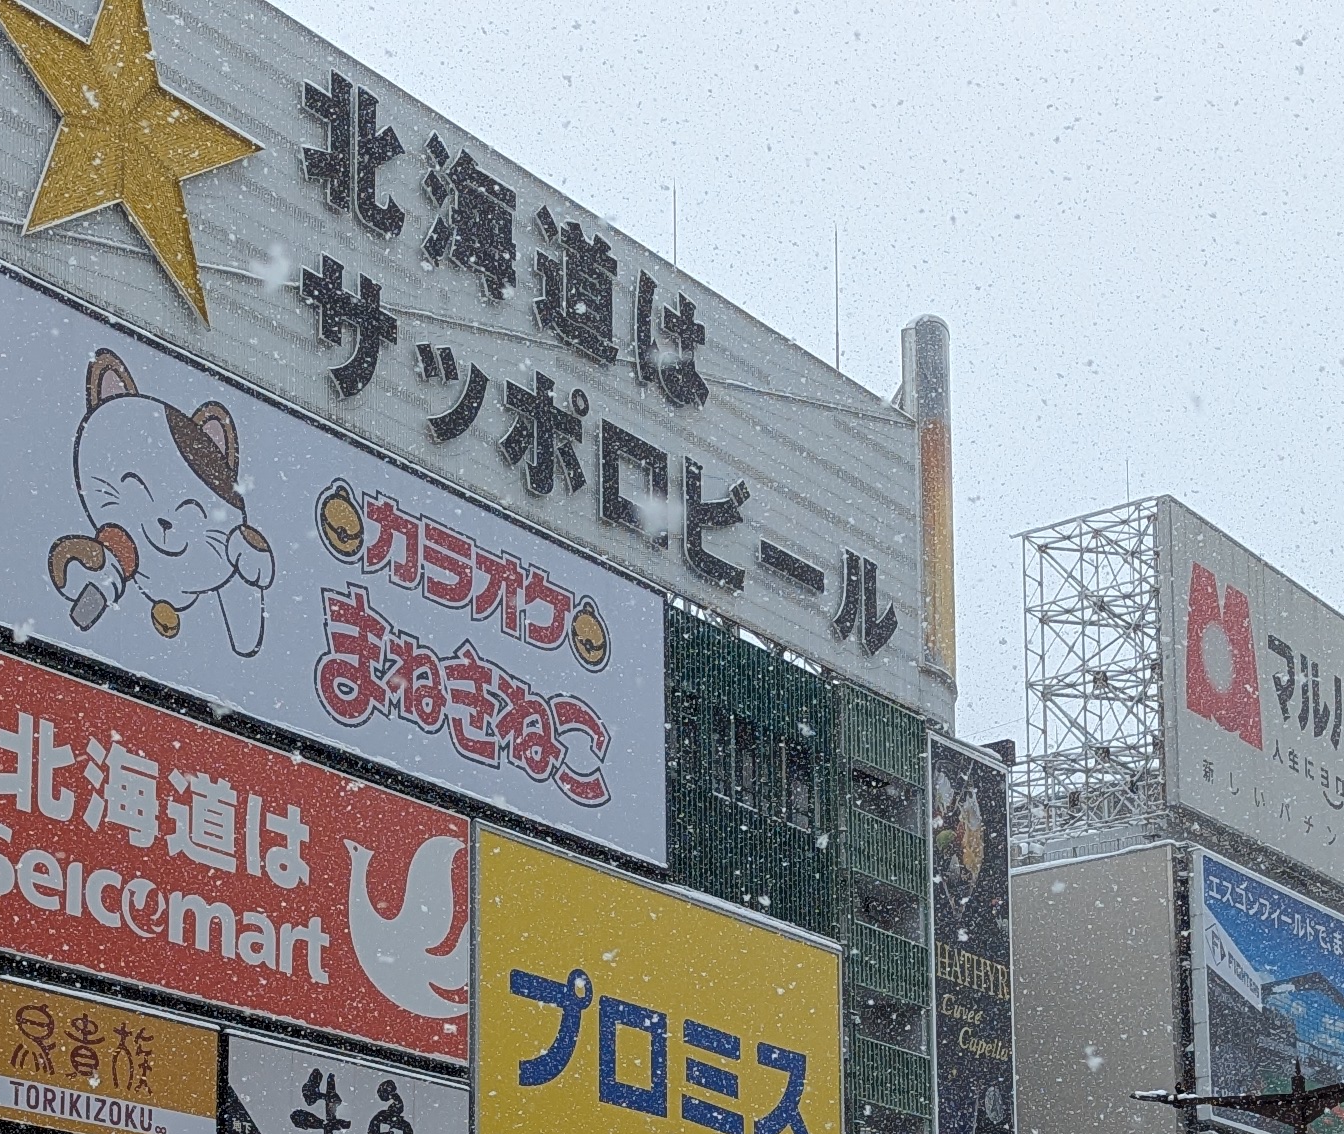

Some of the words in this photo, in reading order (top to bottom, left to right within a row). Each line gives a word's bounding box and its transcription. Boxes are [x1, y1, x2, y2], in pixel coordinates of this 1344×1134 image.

[298, 68, 711, 411] 北海道は
[297, 252, 899, 658] サッポロビール
[358, 488, 579, 651] カラオケ
[313, 582, 613, 809] まねきねこ
[935, 940, 1010, 1001] HATHYR
[958, 1026, 1010, 1062] Capella
